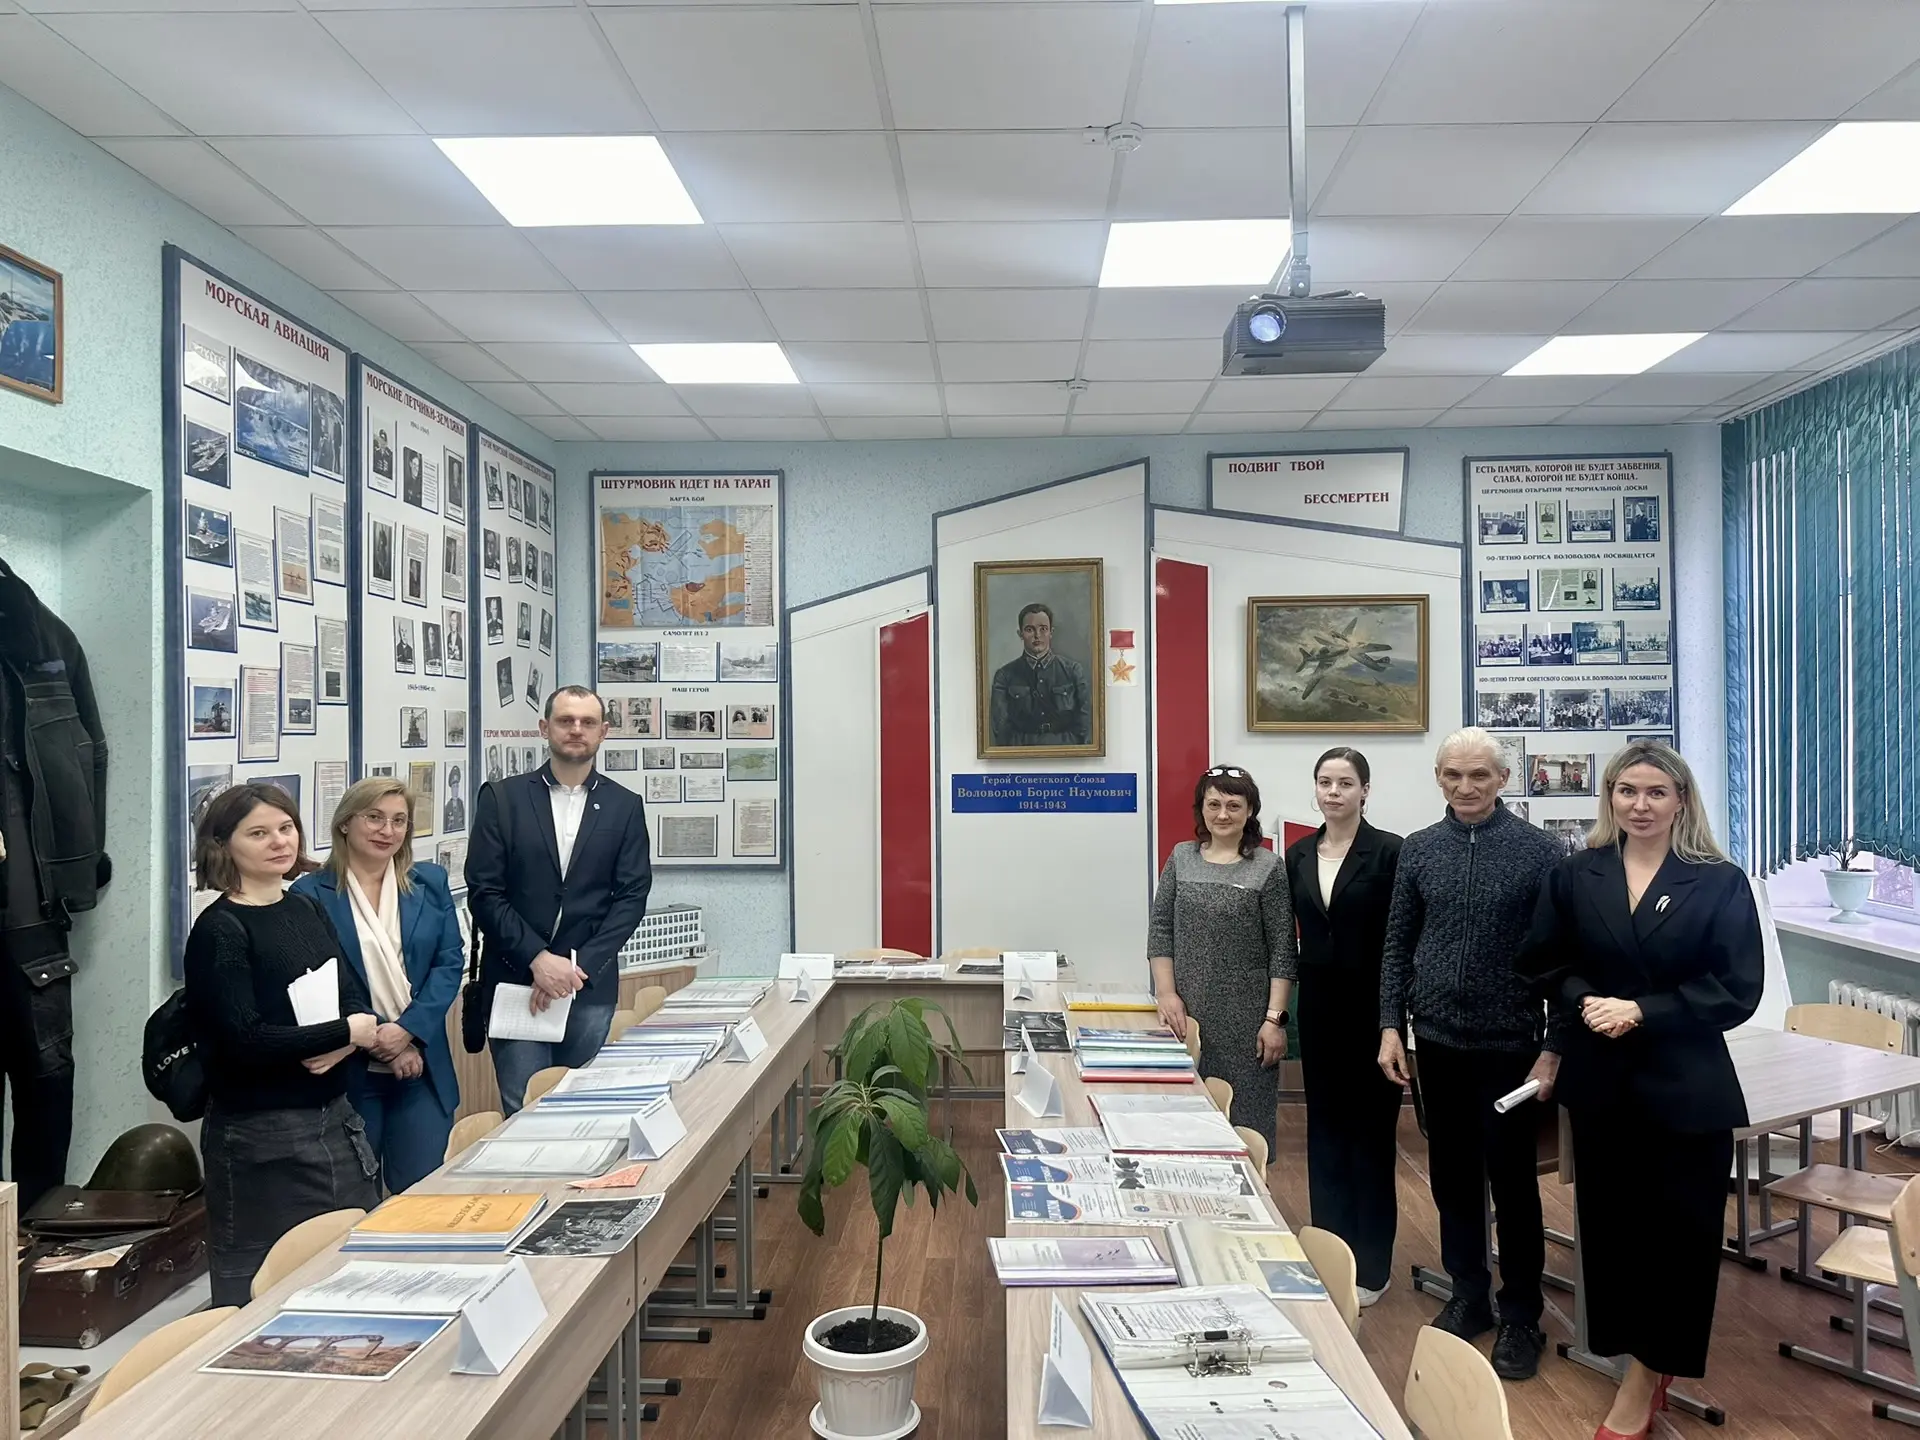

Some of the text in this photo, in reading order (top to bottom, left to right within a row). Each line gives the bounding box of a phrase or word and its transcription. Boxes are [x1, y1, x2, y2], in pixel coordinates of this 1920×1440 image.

[205, 279, 330, 362] МОРСКАЯ АВИАЦИЯ
[366, 372, 464, 437] МОРСКИЕ ЛЕТЧИКИ-ЗЕМЛЯКИ
[1228, 459, 1325, 475] ПОДВИГ ТВОЙ
[1476, 466, 1496, 474] ЕСТЬ
[1534, 464, 1572, 472] КОТОРОЙ
[1588, 463, 1614, 472] БУДЕТ
[1525, 474, 1563, 482] КОТОРОЙ
[1565, 474, 1576, 482] НЕ
[1578, 473, 1604, 482] БУДЕТ
[600, 478, 771, 490] ШТУРМОВИК ИДЕТ НА ТАРАН
[1304, 492, 1389, 504] БЕССМЕРТЕН
[982, 774, 1106, 786] Герой Советского Союза
[958, 787, 1132, 799] Воловодов Борис Наумович
[1018, 801, 1066, 810] 1914-1943
[157, 1046, 190, 1071] LOVE
